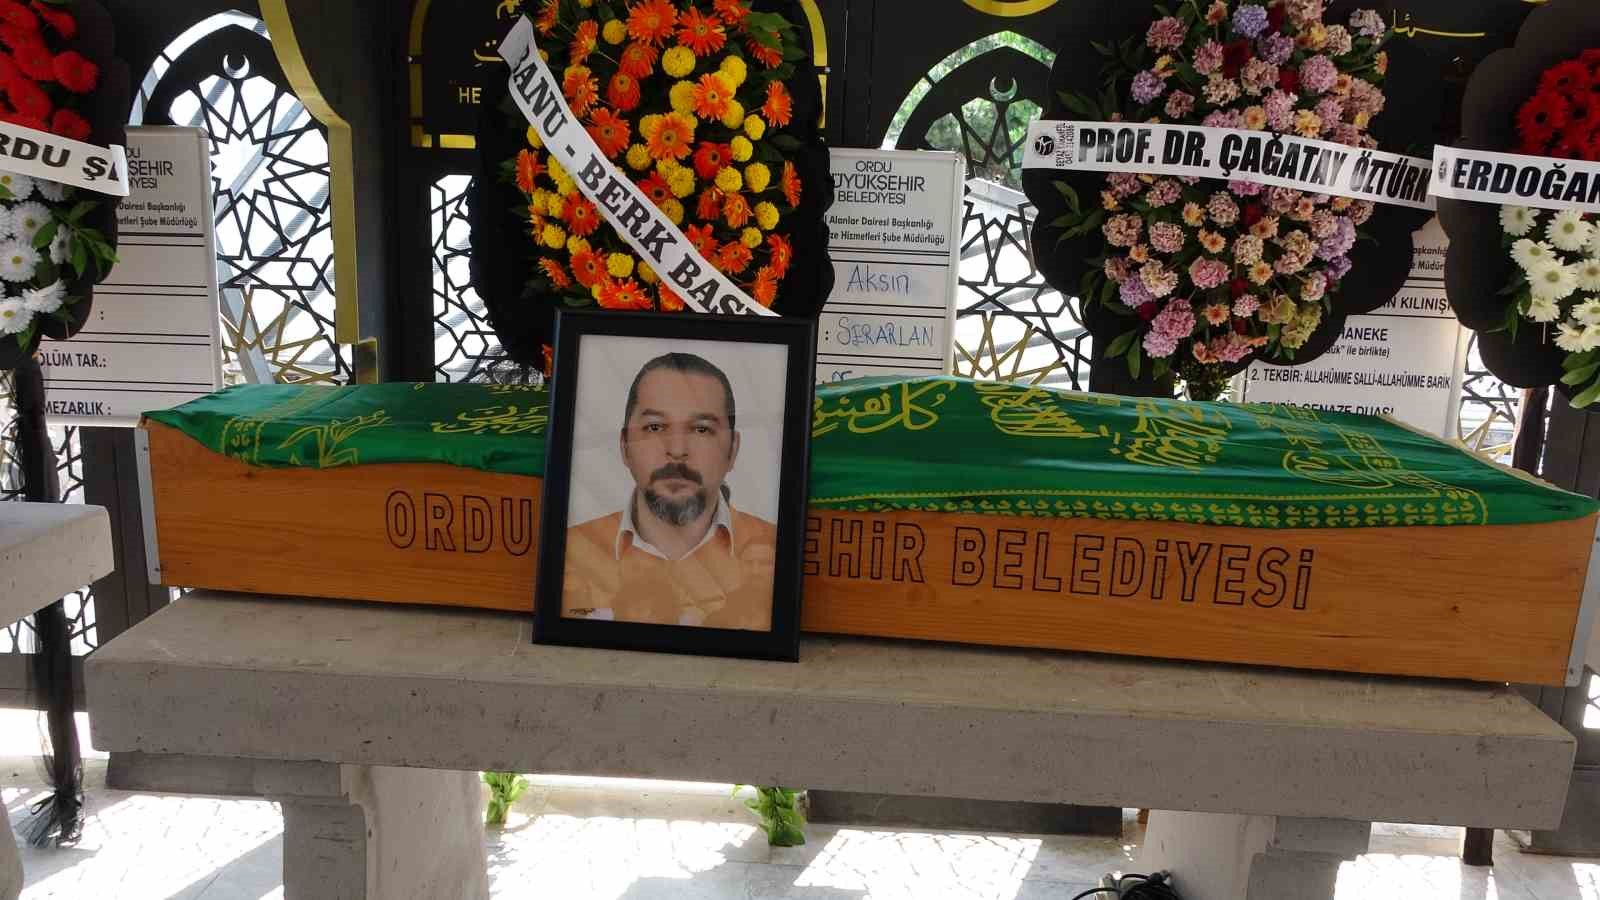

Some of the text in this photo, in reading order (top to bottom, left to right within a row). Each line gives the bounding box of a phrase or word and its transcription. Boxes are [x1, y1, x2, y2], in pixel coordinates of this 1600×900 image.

[459, 87, 482, 104] HE
[1078, 127, 1155, 164] PROF.
[1161, 129, 1211, 168] DR.
[1218, 132, 1349, 188] ÇAĞATAY
[855, 160, 892, 173] ORDU
[512, 62, 568, 138] ANU
[577, 153, 677, 263] BERK
[667, 253, 759, 315] BAS
[829, 215, 859, 225] Alanlar
[861, 216, 890, 226] Dairesi
[891, 217, 934, 230] Başkanlığı
[841, 230, 881, 241] Hizmetleri
[882, 231, 902, 244] Şube
[903, 232, 945, 246] Müdürlüğü
[1341, 326, 1389, 341] ANEKE
[1251, 368, 1260, 381] 2.
[384, 489, 533, 557] ORDU
